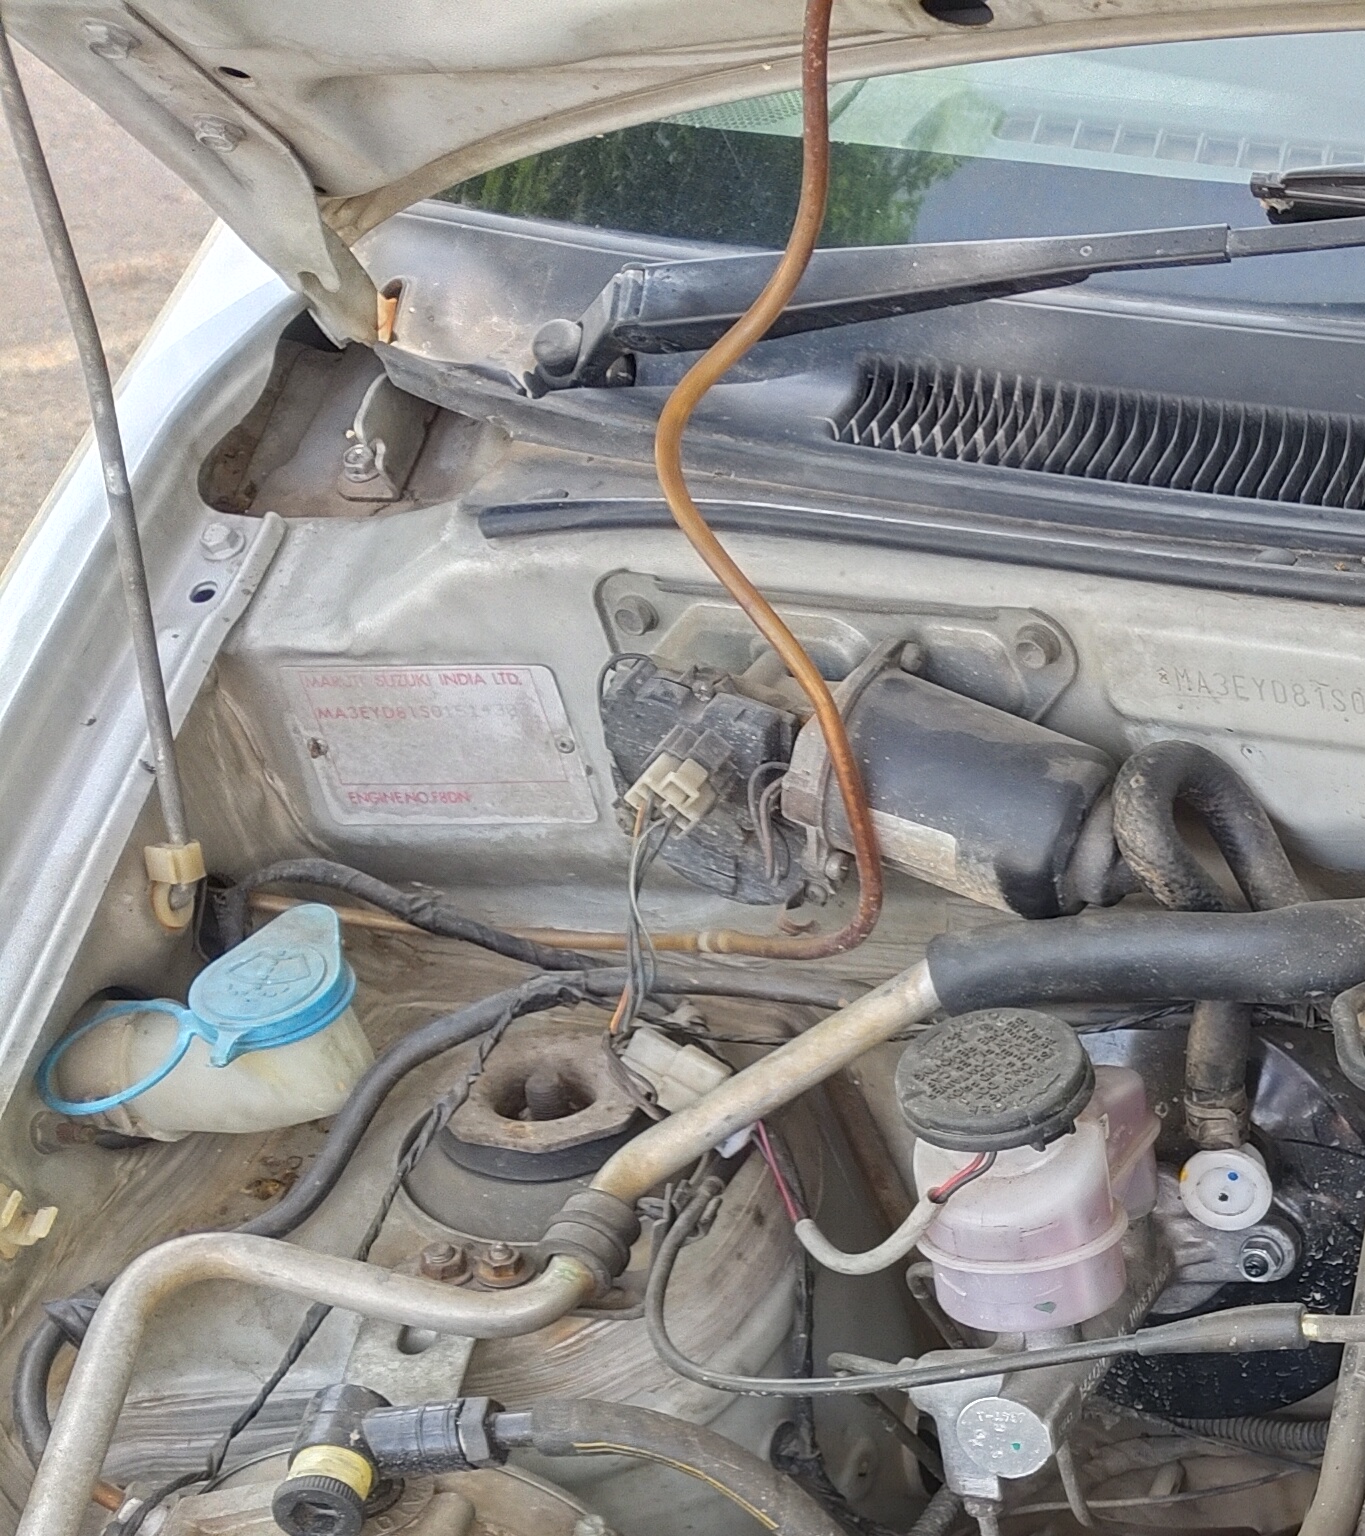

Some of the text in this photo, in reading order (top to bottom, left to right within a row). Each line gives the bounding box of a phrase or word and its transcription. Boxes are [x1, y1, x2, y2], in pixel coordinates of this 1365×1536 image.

[375, 673, 431, 687] SUZUKI
[439, 672, 487, 686] INDIA
[493, 672, 523, 686] LTD.
[348, 791, 403, 805] ENGINE
